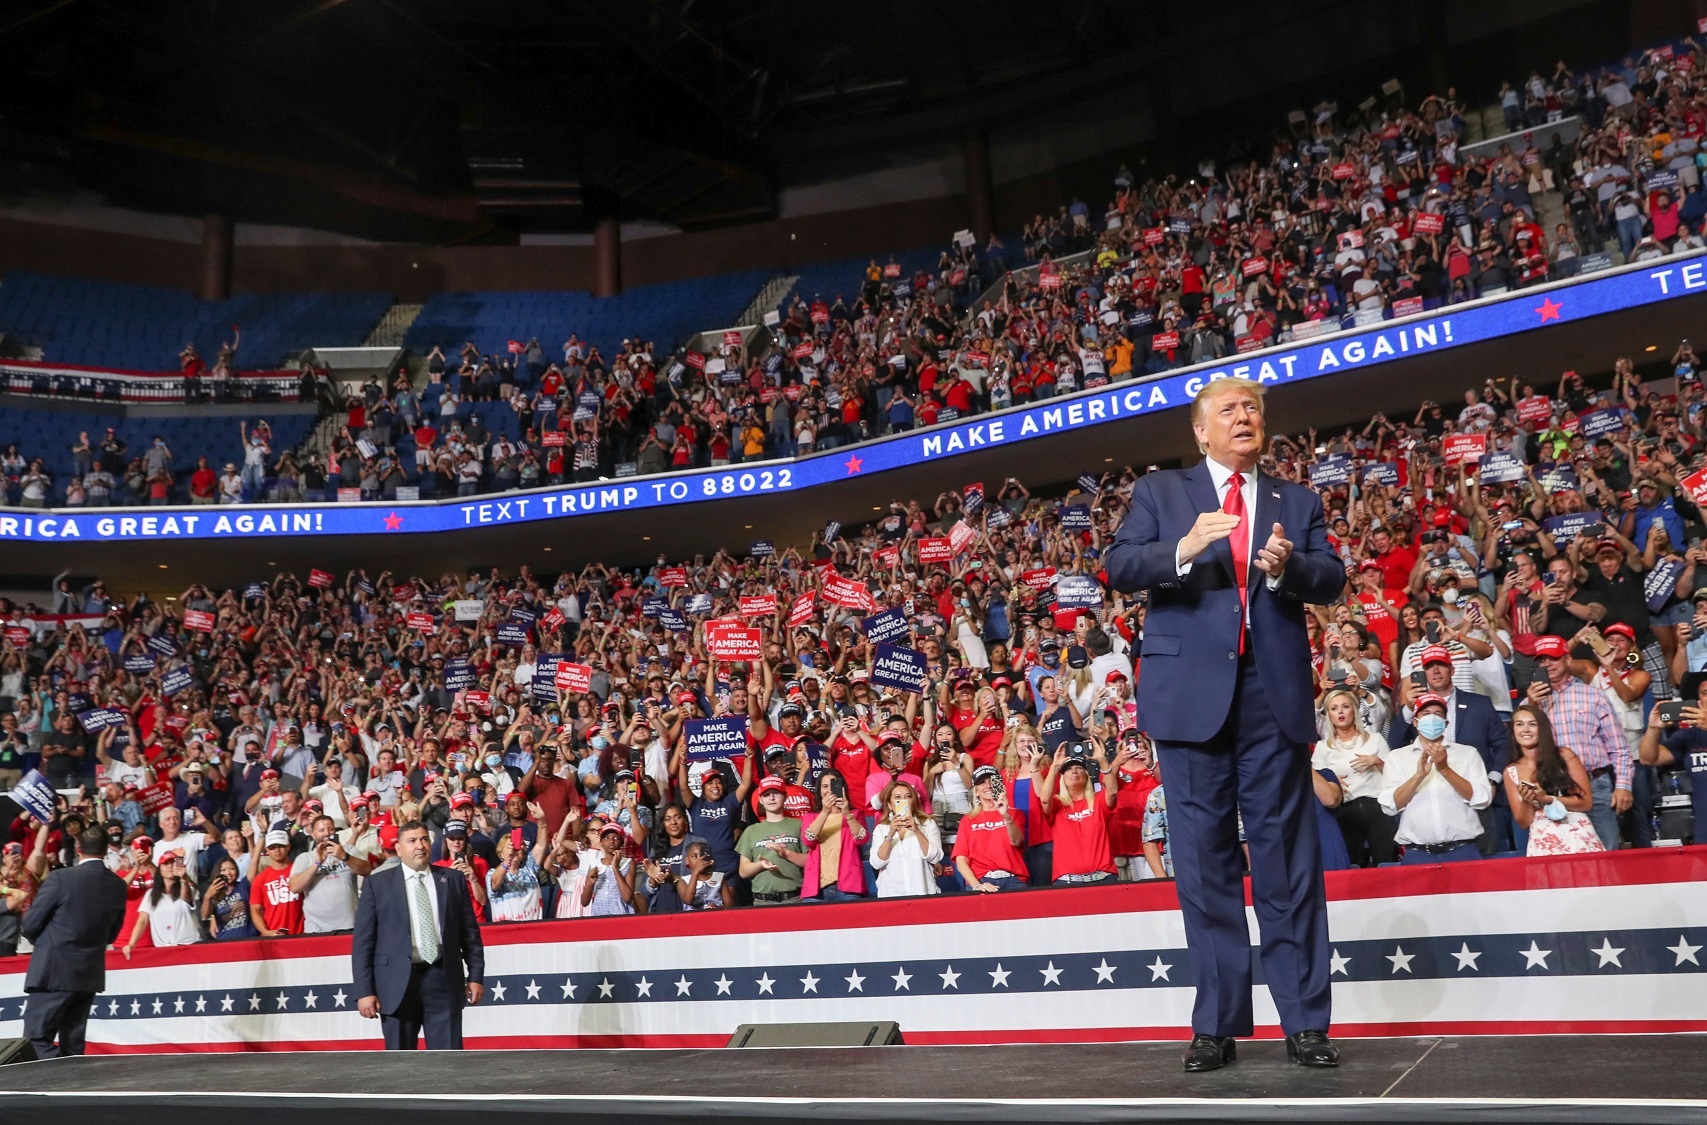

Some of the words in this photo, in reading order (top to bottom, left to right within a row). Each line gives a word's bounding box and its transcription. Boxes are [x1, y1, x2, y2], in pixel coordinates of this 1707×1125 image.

[923, 422, 1004, 457] MAKE
[1021, 386, 1168, 436] AMERICA
[1318, 320, 1452, 371] AGAIN!
[1520, 404, 1548, 413] AMERICA
[1591, 413, 1608, 421] MAKE
[1584, 417, 1621, 430] AMERICA
[1446, 444, 1482, 454] AMERICA
[1481, 460, 1524, 472] AMERICA
[1311, 468, 1345, 479] AMERICA
[461, 500, 530, 524] TEXT
[542, 484, 638, 515] TRUMP
[651, 481, 688, 502] TO
[703, 469, 792, 496] 88022
[988, 512, 1010, 523] AMERICA
[1563, 518, 1585, 526] MAKE
[97, 515, 199, 536] GREAT
[214, 513, 323, 534] AGAIN!
[826, 583, 859, 598] AMERICA
[837, 581, 852, 589] MAKE
[1661, 575, 1674, 596] MAKE
[1060, 587, 1099, 595] AMERICA
[876, 615, 893, 625] MAKE
[1369, 612, 1388, 620] 2020
[868, 618, 906, 637] AMERICA
[891, 626, 909, 635] AGAIN
[716, 640, 759, 648] AMERICA
[892, 651, 912, 663] MAKE
[876, 658, 924, 676] AMERICA
[163, 673, 191, 689] AMERICA
[558, 672, 588, 682] AMERICA
[875, 669, 898, 681] GREAT
[899, 675, 922, 686] AGAIN
[84, 712, 122, 725] AMERICA
[704, 724, 727, 732] MAKE
[688, 731, 744, 744] AMERICA
[689, 745, 716, 753] GREAT
